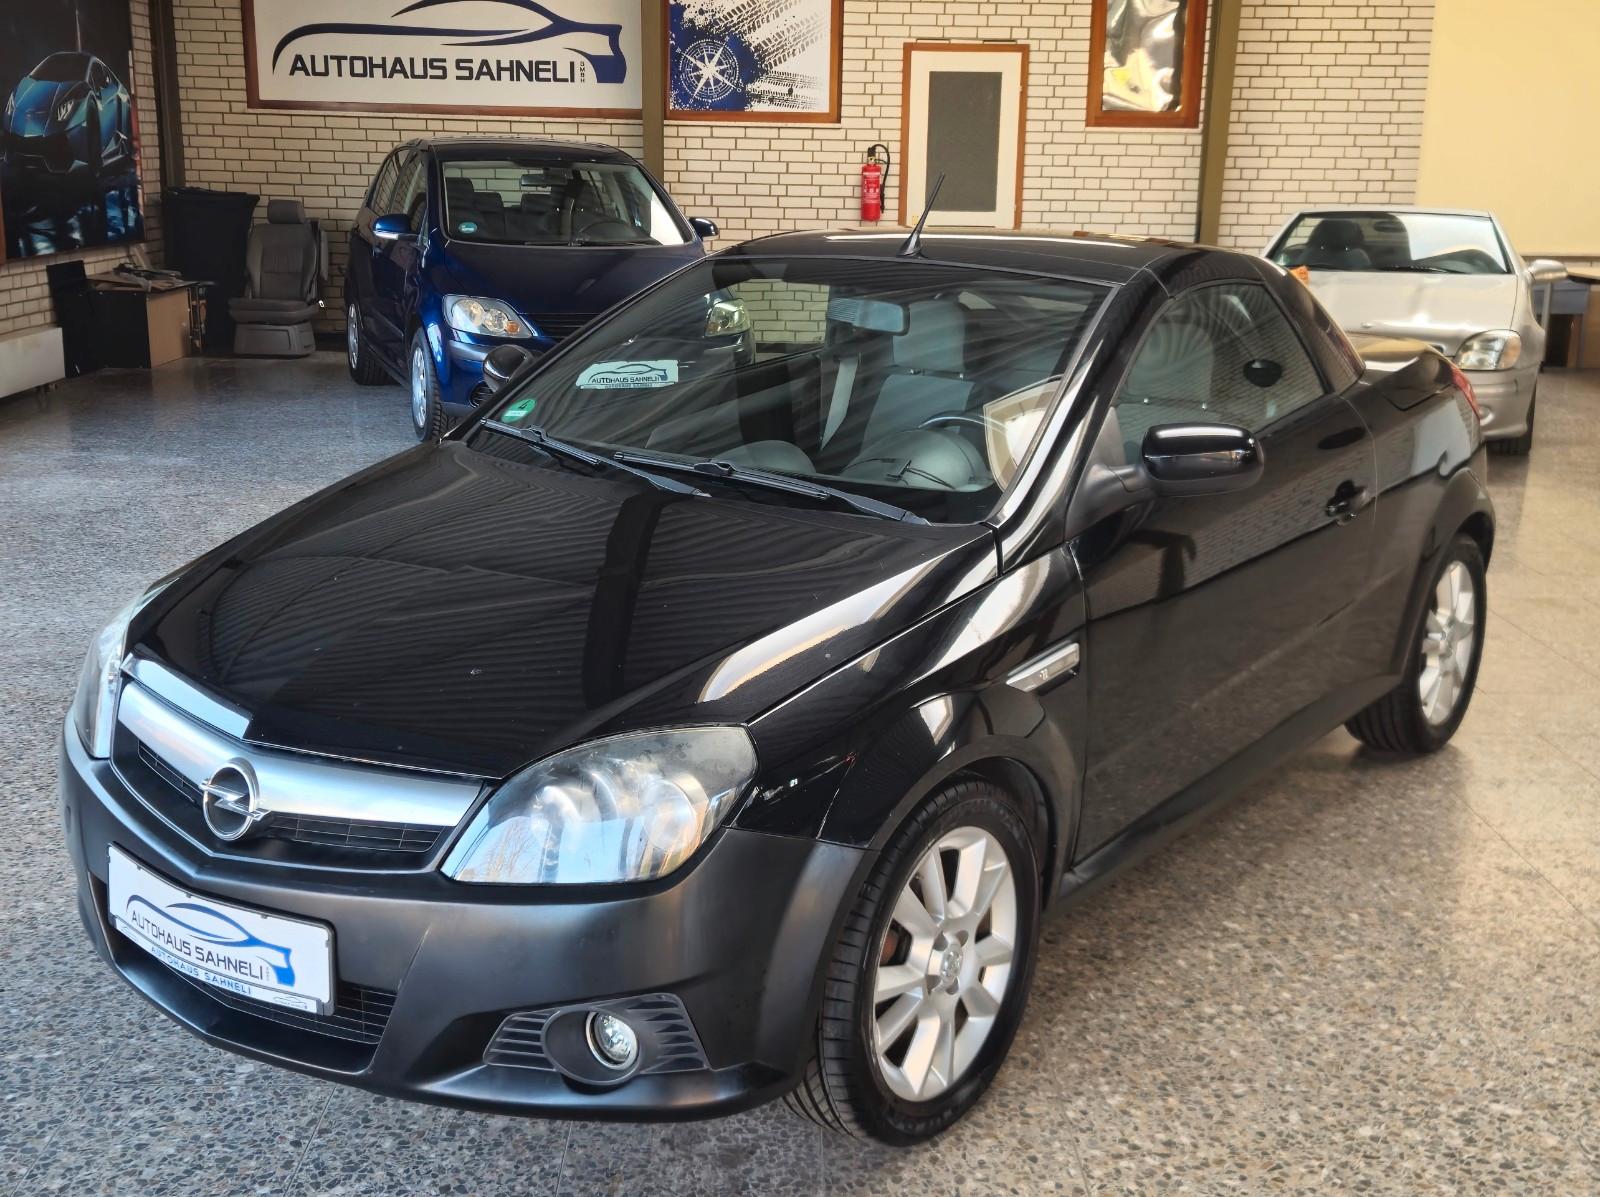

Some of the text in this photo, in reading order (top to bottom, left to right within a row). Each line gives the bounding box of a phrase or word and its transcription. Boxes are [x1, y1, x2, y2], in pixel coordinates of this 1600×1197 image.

[289, 54, 575, 83] AUTOHAUS SAHNELI
[131, 910, 263, 980] AUTOHAUS SAHNELI
[151, 946, 200, 977] AUTOHAUS
[204, 972, 251, 995] SAHNELI
